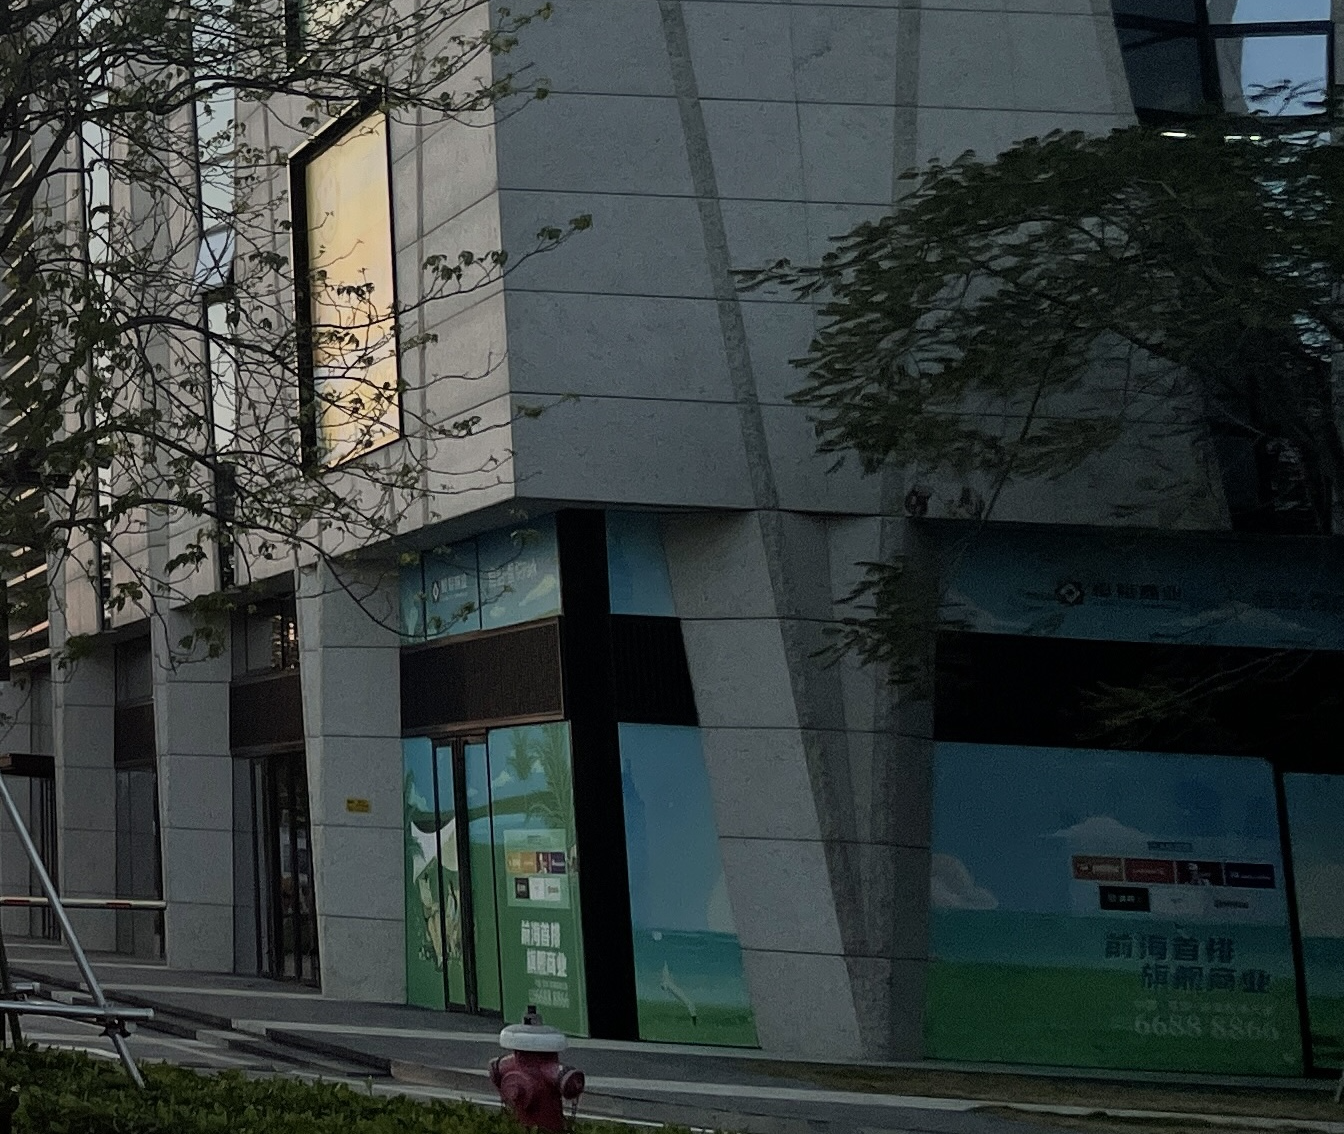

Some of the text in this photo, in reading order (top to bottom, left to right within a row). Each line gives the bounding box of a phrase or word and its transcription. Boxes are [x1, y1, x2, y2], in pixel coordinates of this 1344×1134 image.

[1105, 932, 1234, 965] 前海首排
[1134, 1015, 1203, 1038] 6688
